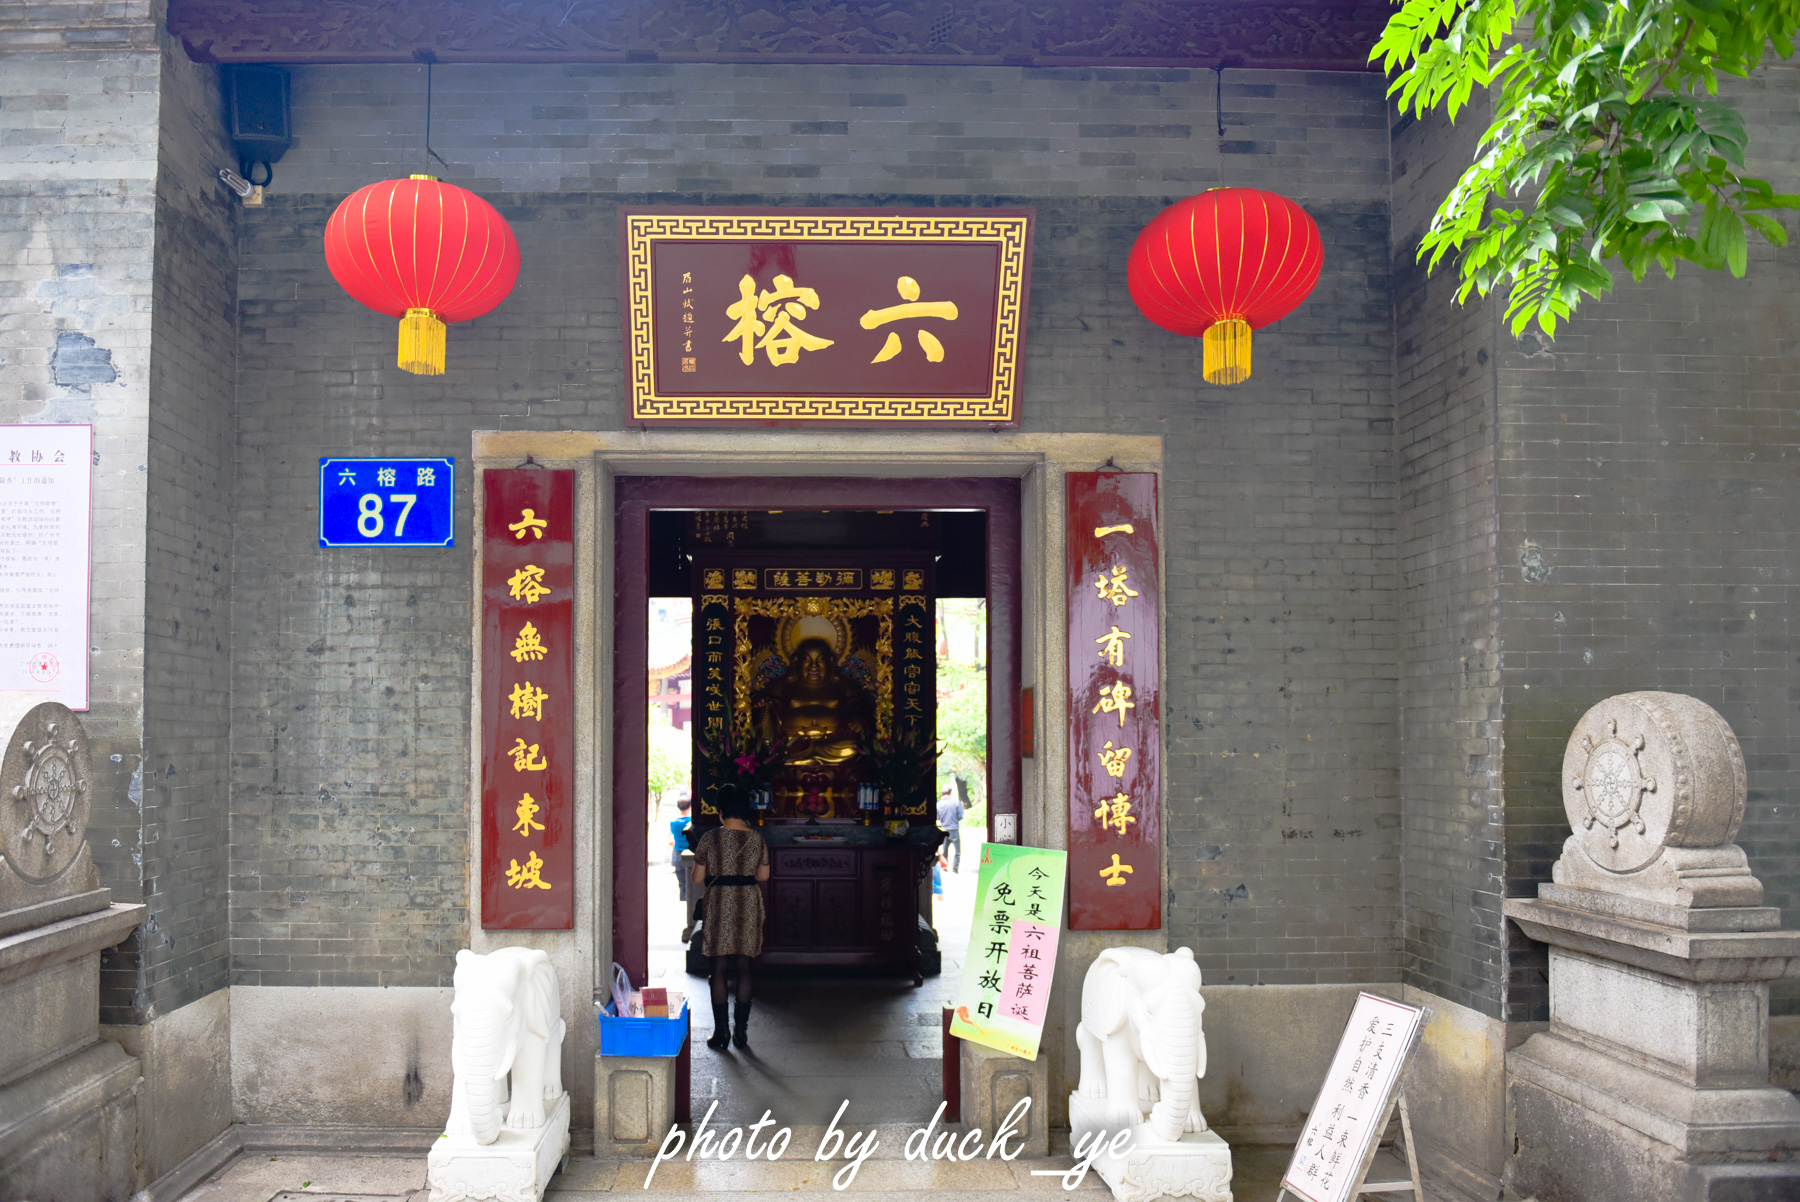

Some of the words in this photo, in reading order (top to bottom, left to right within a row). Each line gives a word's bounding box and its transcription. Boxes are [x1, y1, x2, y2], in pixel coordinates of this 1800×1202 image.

[722, 273, 958, 367] 六榕
[338, 467, 436, 487] 六榕路
[357, 493, 417, 538] 87
[977, 882, 1016, 1020] 免票开放日
[1010, 866, 1050, 1021] 今天是六祖菩萨诞
